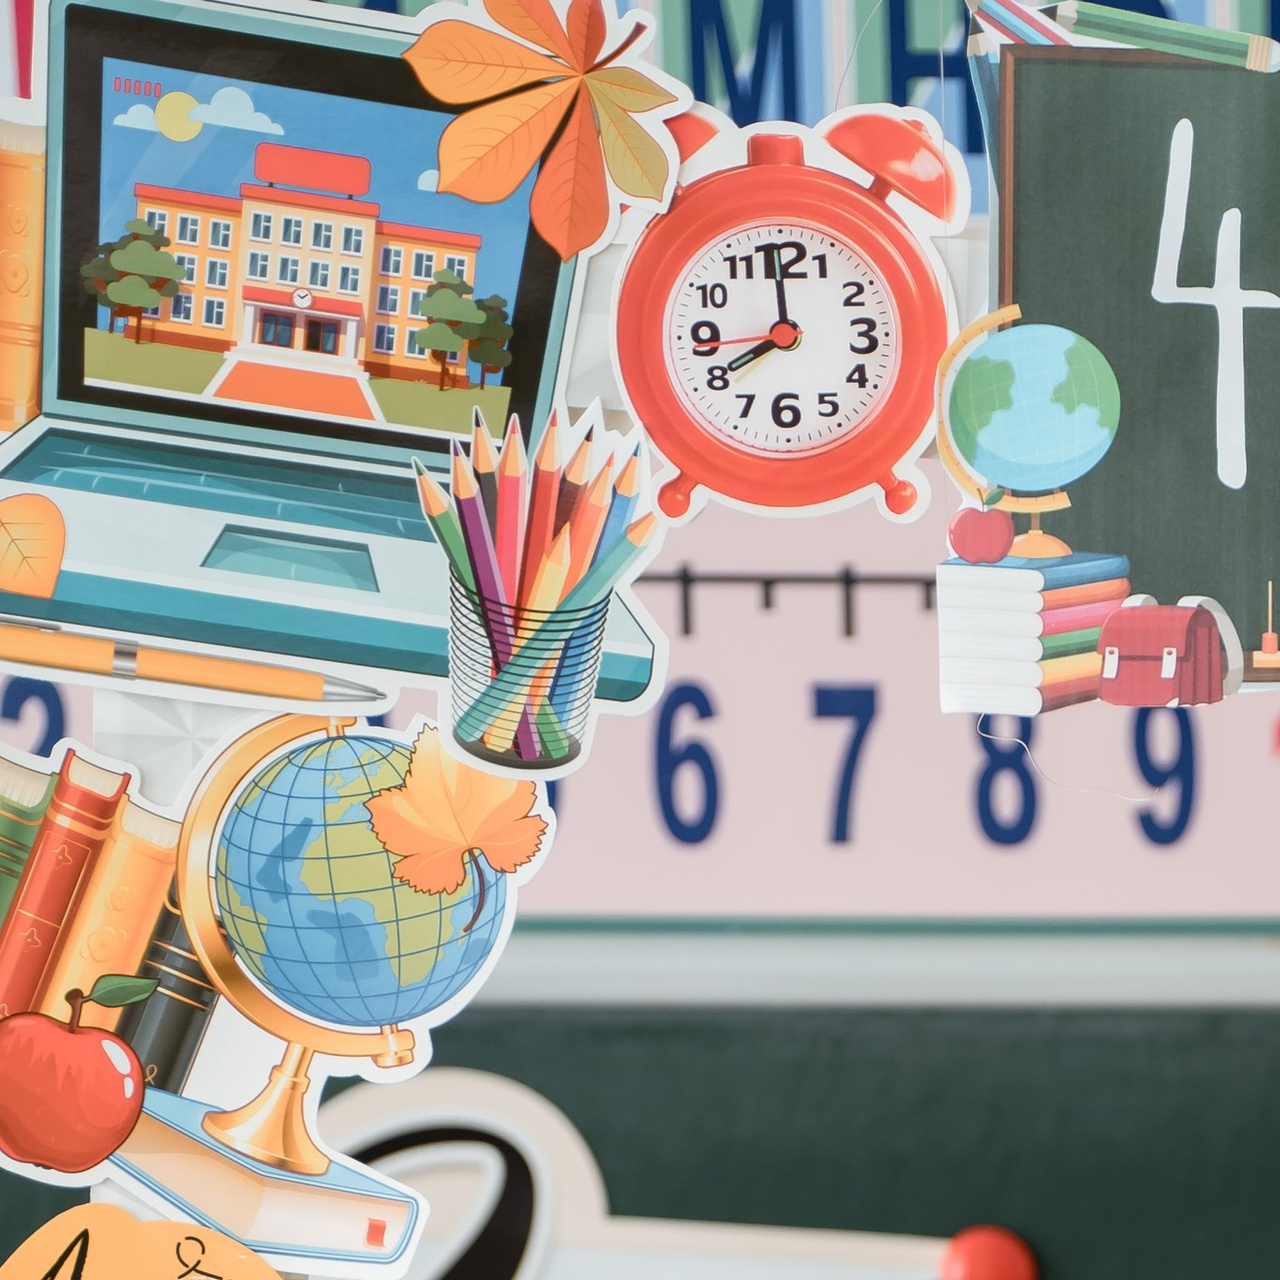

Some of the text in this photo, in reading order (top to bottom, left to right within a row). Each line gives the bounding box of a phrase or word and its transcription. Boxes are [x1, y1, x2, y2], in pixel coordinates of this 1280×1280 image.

[723, 255, 753, 279] 11
[812, 254, 827, 278] 1
[696, 283, 728, 308] 10
[843, 282, 865, 306] 2
[691, 321, 720, 356] 9
[850, 317, 878, 354] 3
[706, 366, 729, 390] 8
[846, 364, 868, 388] 4
[735, 394, 756, 418] 7
[771, 393, 801, 428] 6
[818, 393, 839, 417] 5
[652, 681, 722, 845] 6
[812, 682, 880, 845] 7
[975, 713, 1042, 846] 8
[1132, 705, 1196, 846] 9
